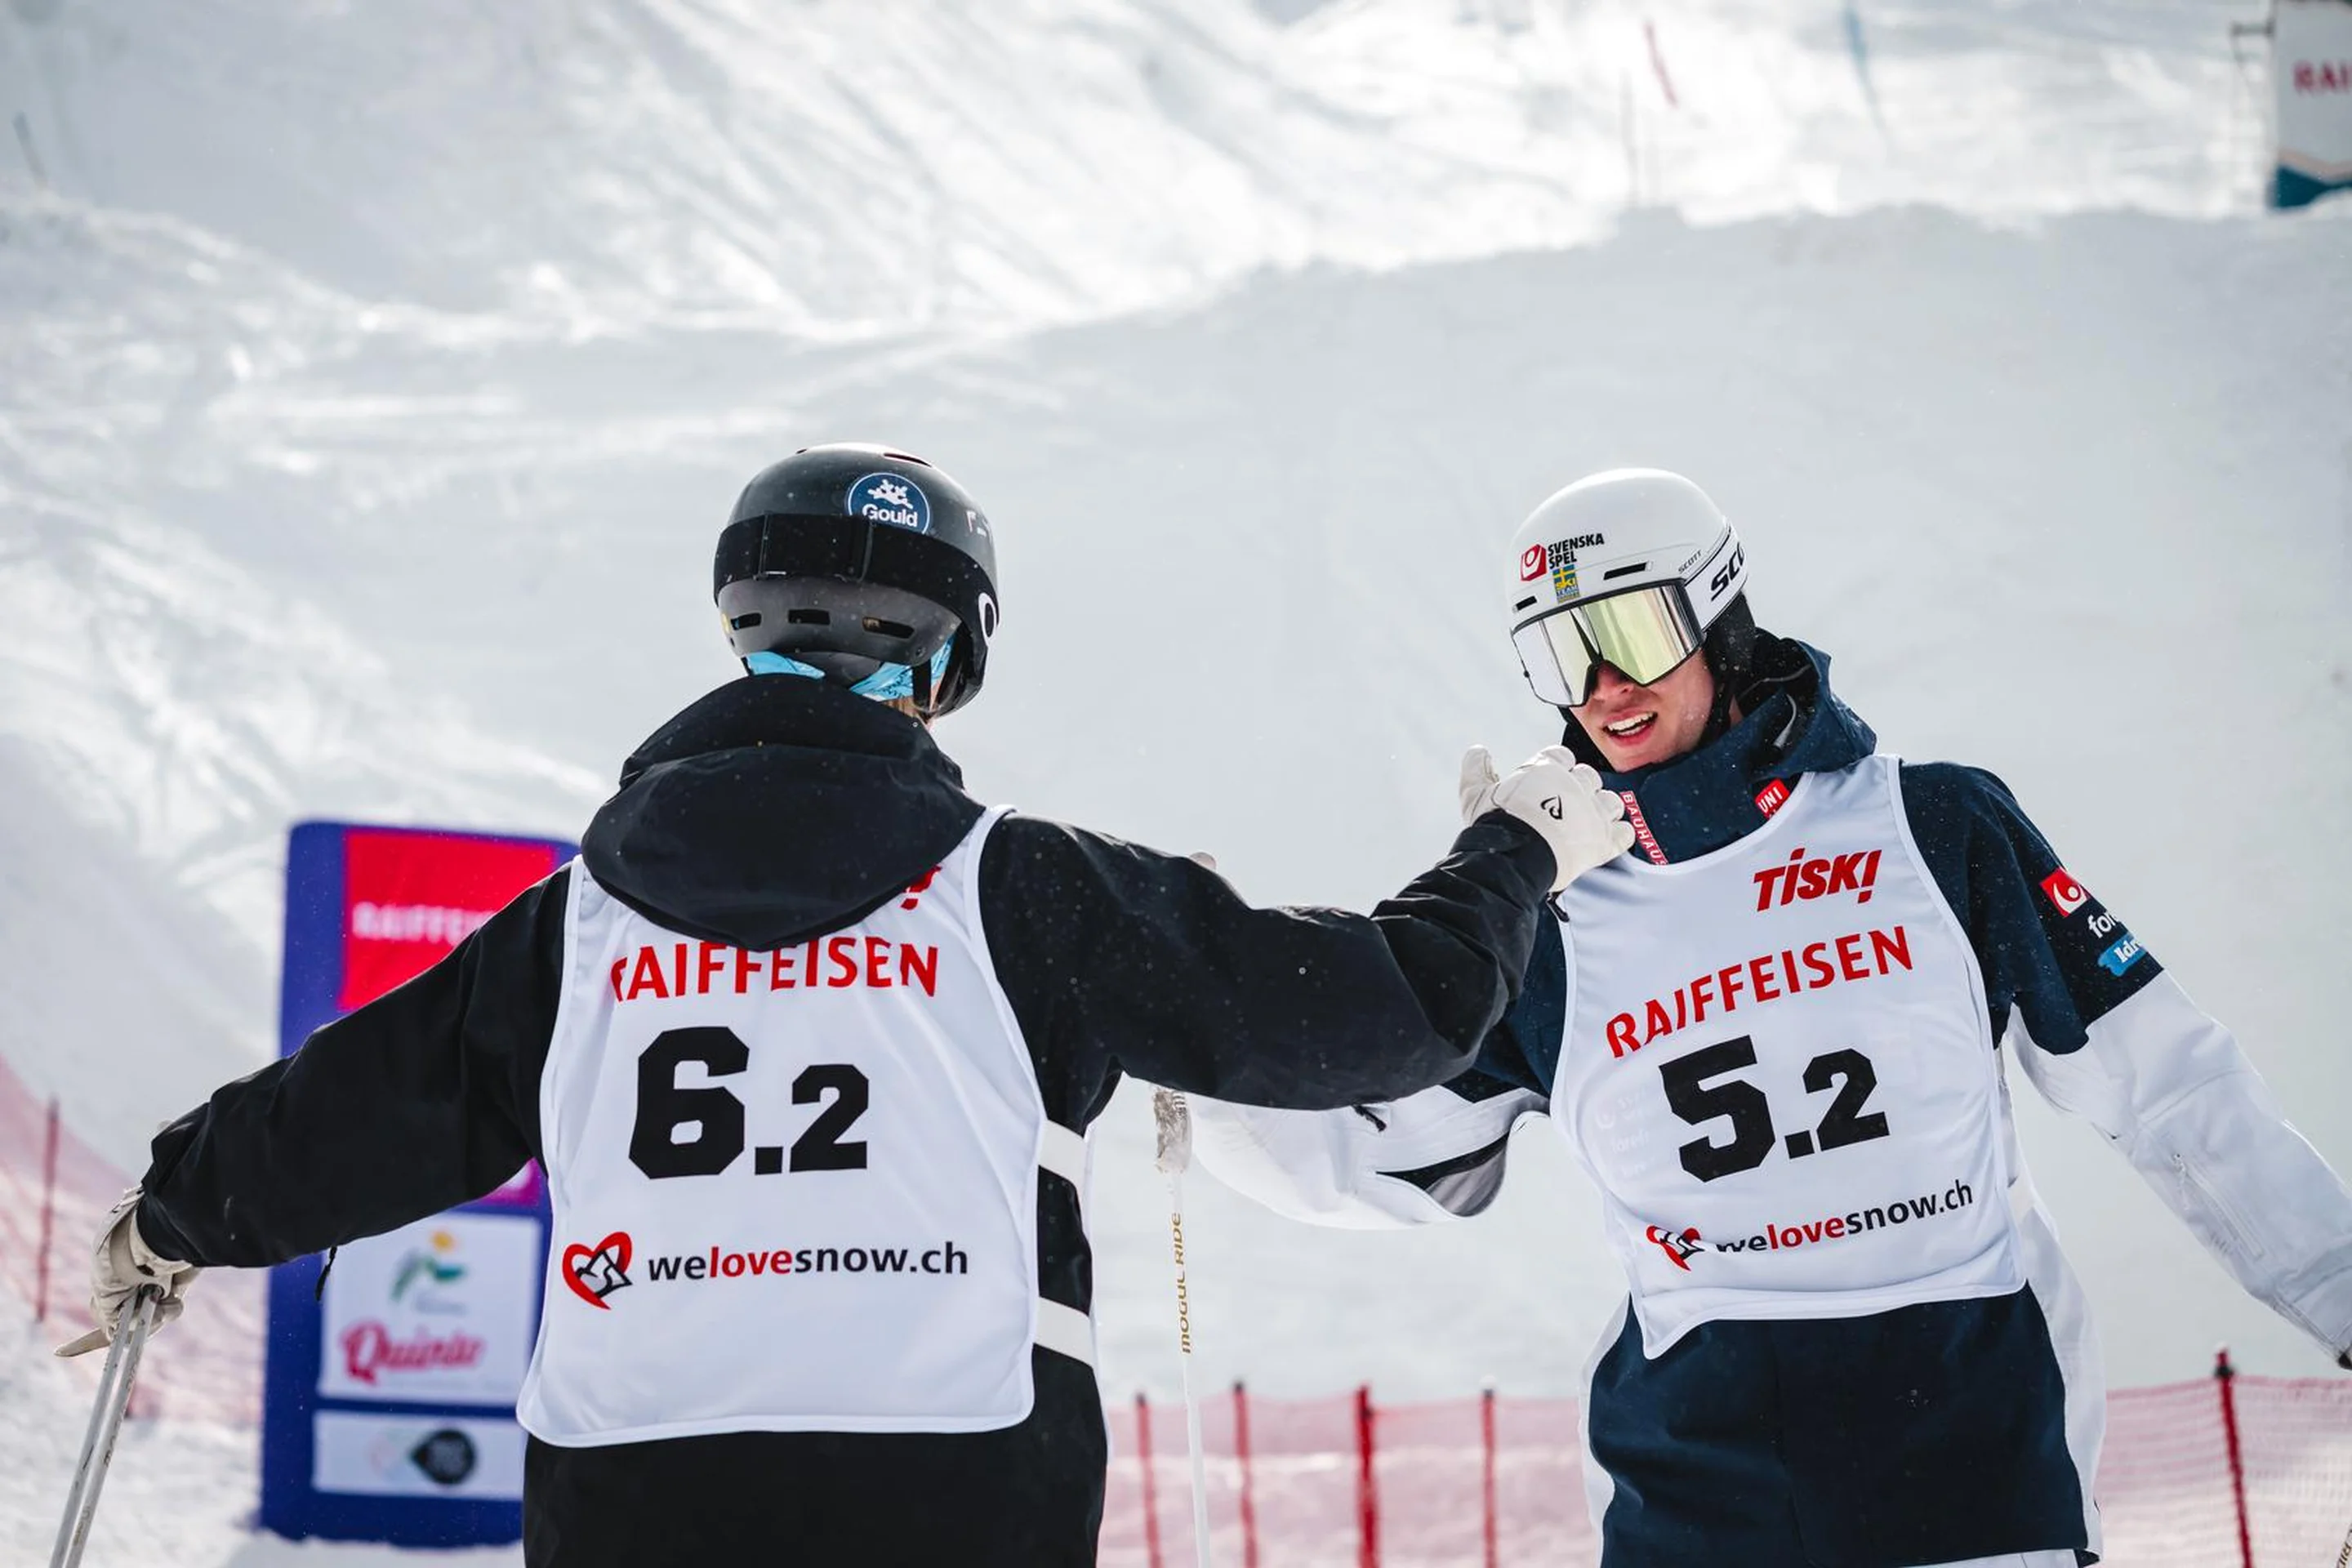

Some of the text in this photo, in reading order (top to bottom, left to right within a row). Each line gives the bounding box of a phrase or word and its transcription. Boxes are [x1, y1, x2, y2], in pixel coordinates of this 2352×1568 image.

[862, 503, 918, 528] Gould
[1548, 532, 1605, 557] SVENSKA
[1548, 550, 1577, 569] SPEL
[1606, 925, 1913, 1059] RAIFFEISEN
[629, 1026, 870, 1179] 6.2
[1659, 1035, 1890, 1183] 5.2
[1716, 1179, 1973, 1253] welovesnow.ch
[648, 1241, 969, 1281] welovesnow.ch
